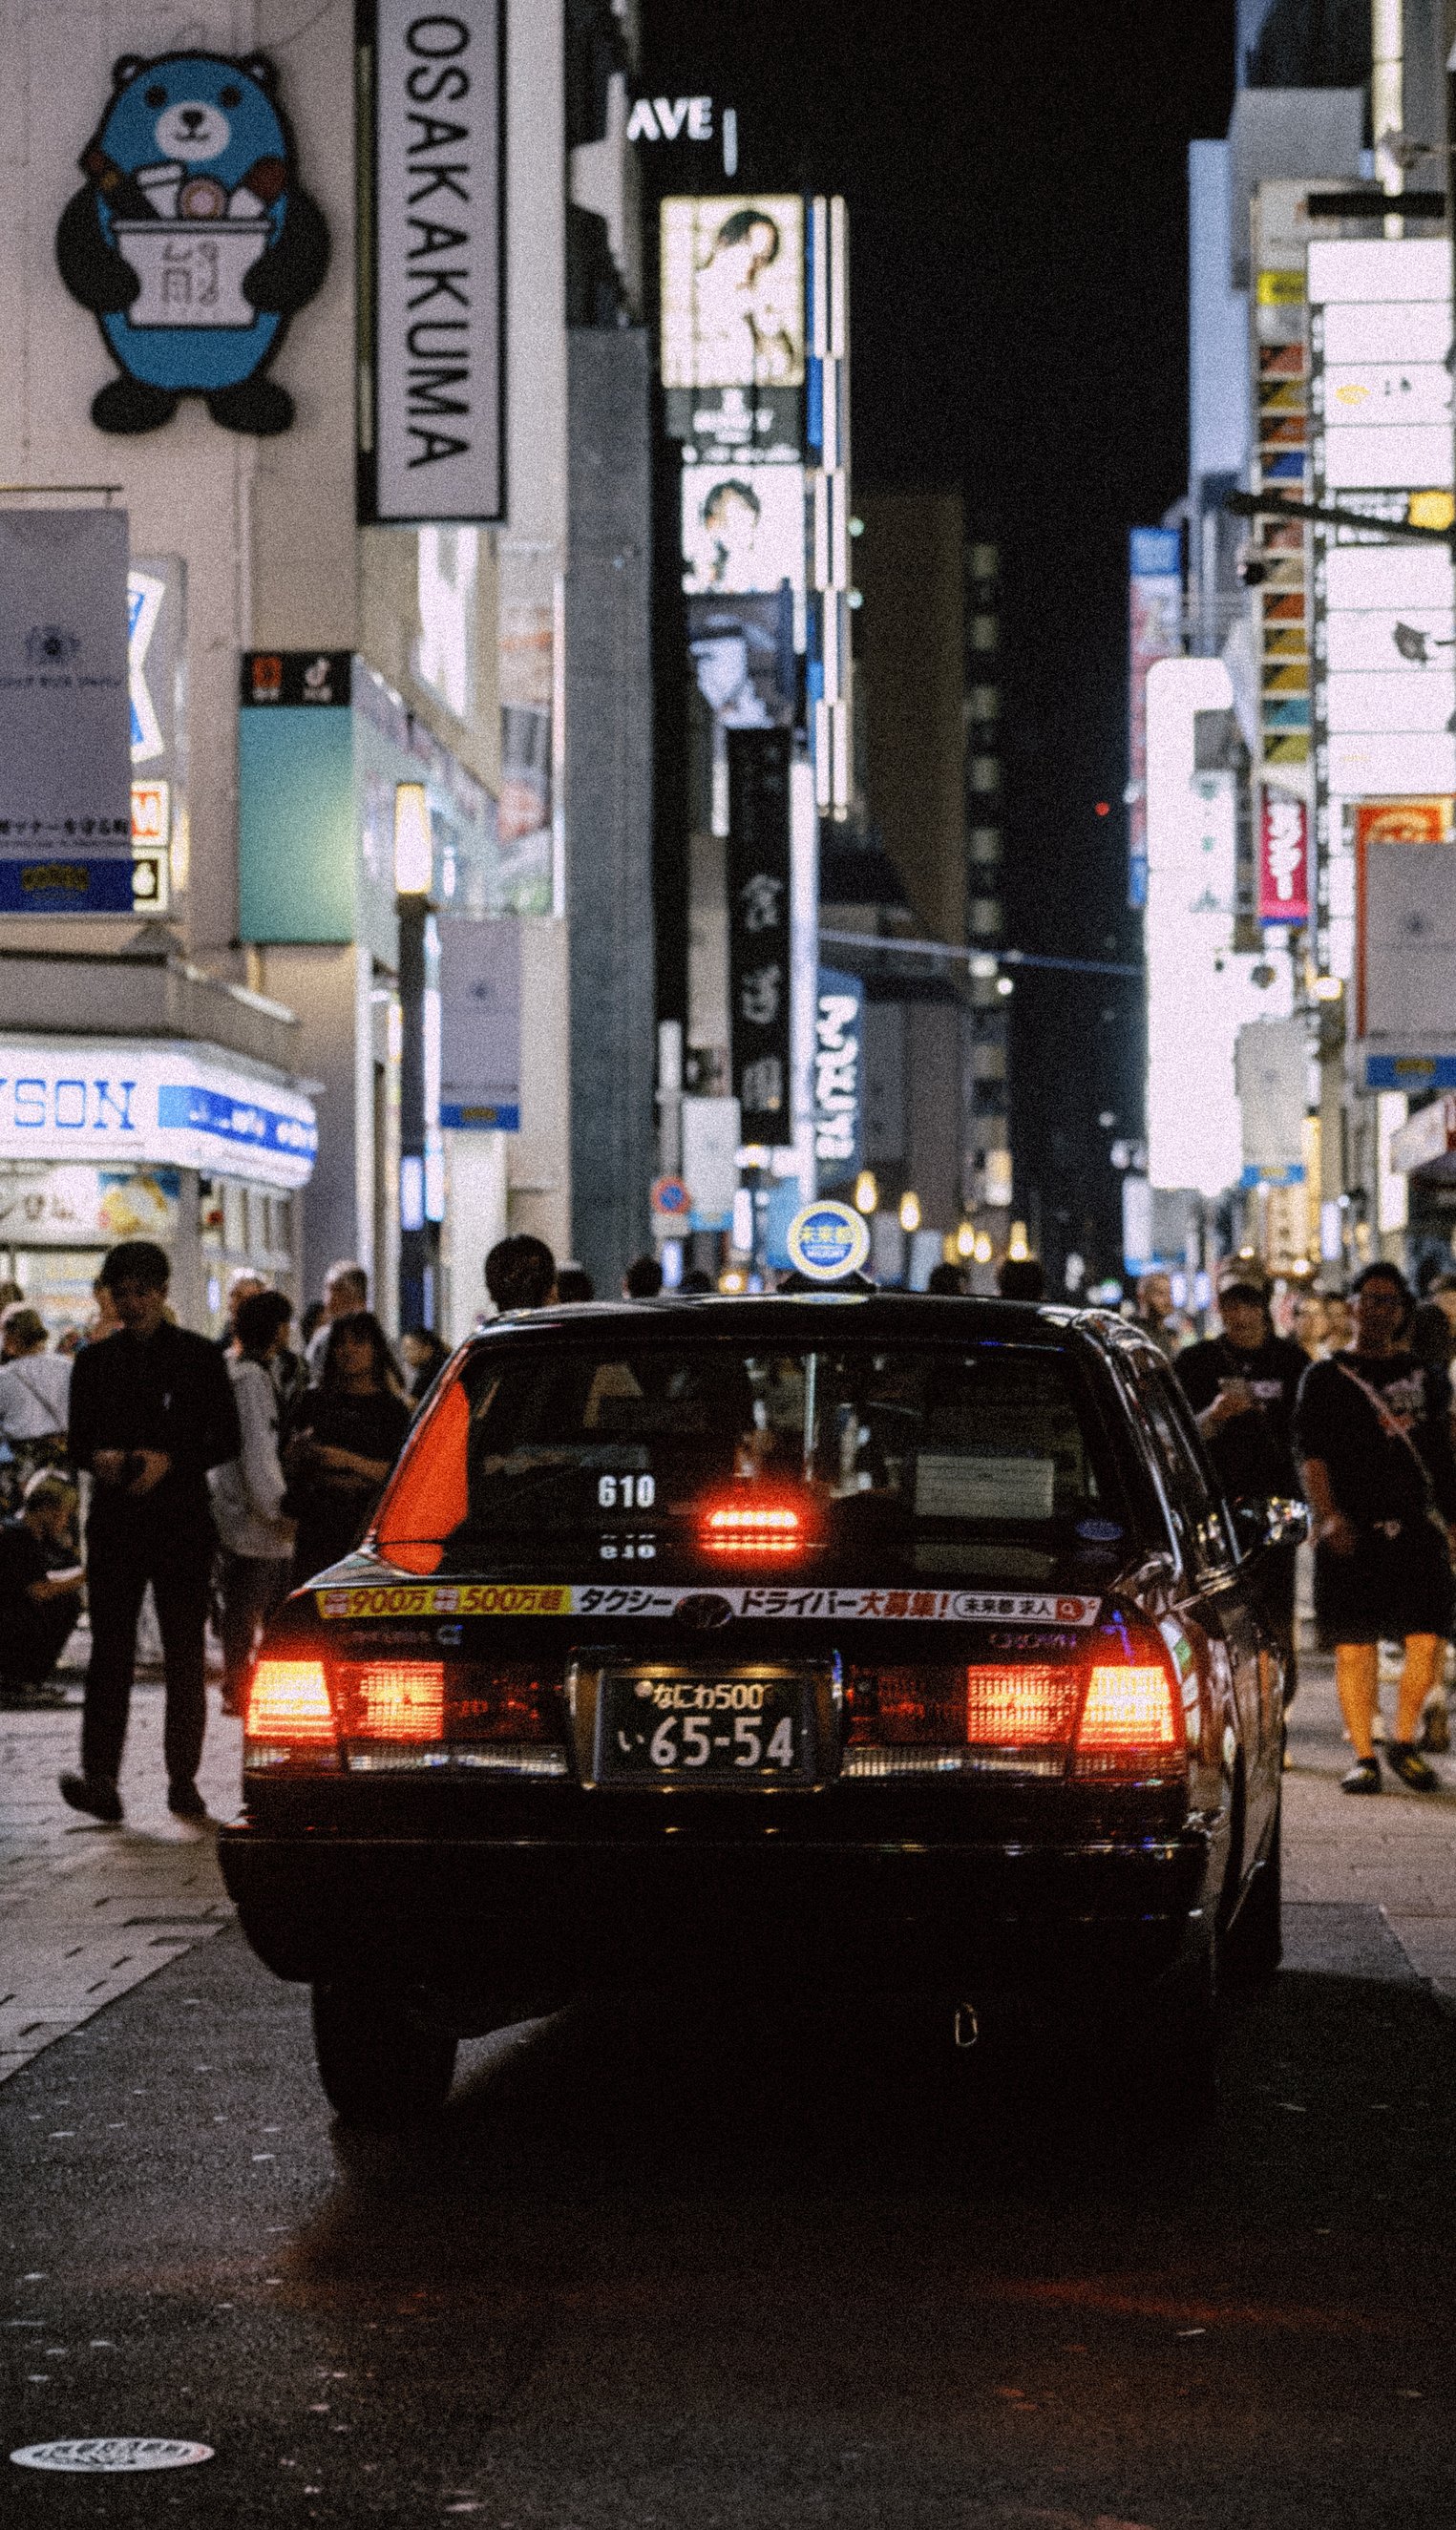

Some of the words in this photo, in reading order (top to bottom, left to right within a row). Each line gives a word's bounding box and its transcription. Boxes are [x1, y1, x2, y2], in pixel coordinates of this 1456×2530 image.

[626, 95, 713, 141] AVE
[405, 14, 471, 470] OSAKAKUMA
[0, 1078, 137, 1130] SON
[598, 1474, 656, 1508] 610
[352, 1589, 429, 1613] 900万
[580, 1588, 672, 1613] タクシー
[1019, 1598, 1051, 1617] 求人
[618, 1730, 645, 1752] い
[650, 1715, 794, 1767] 65-54
